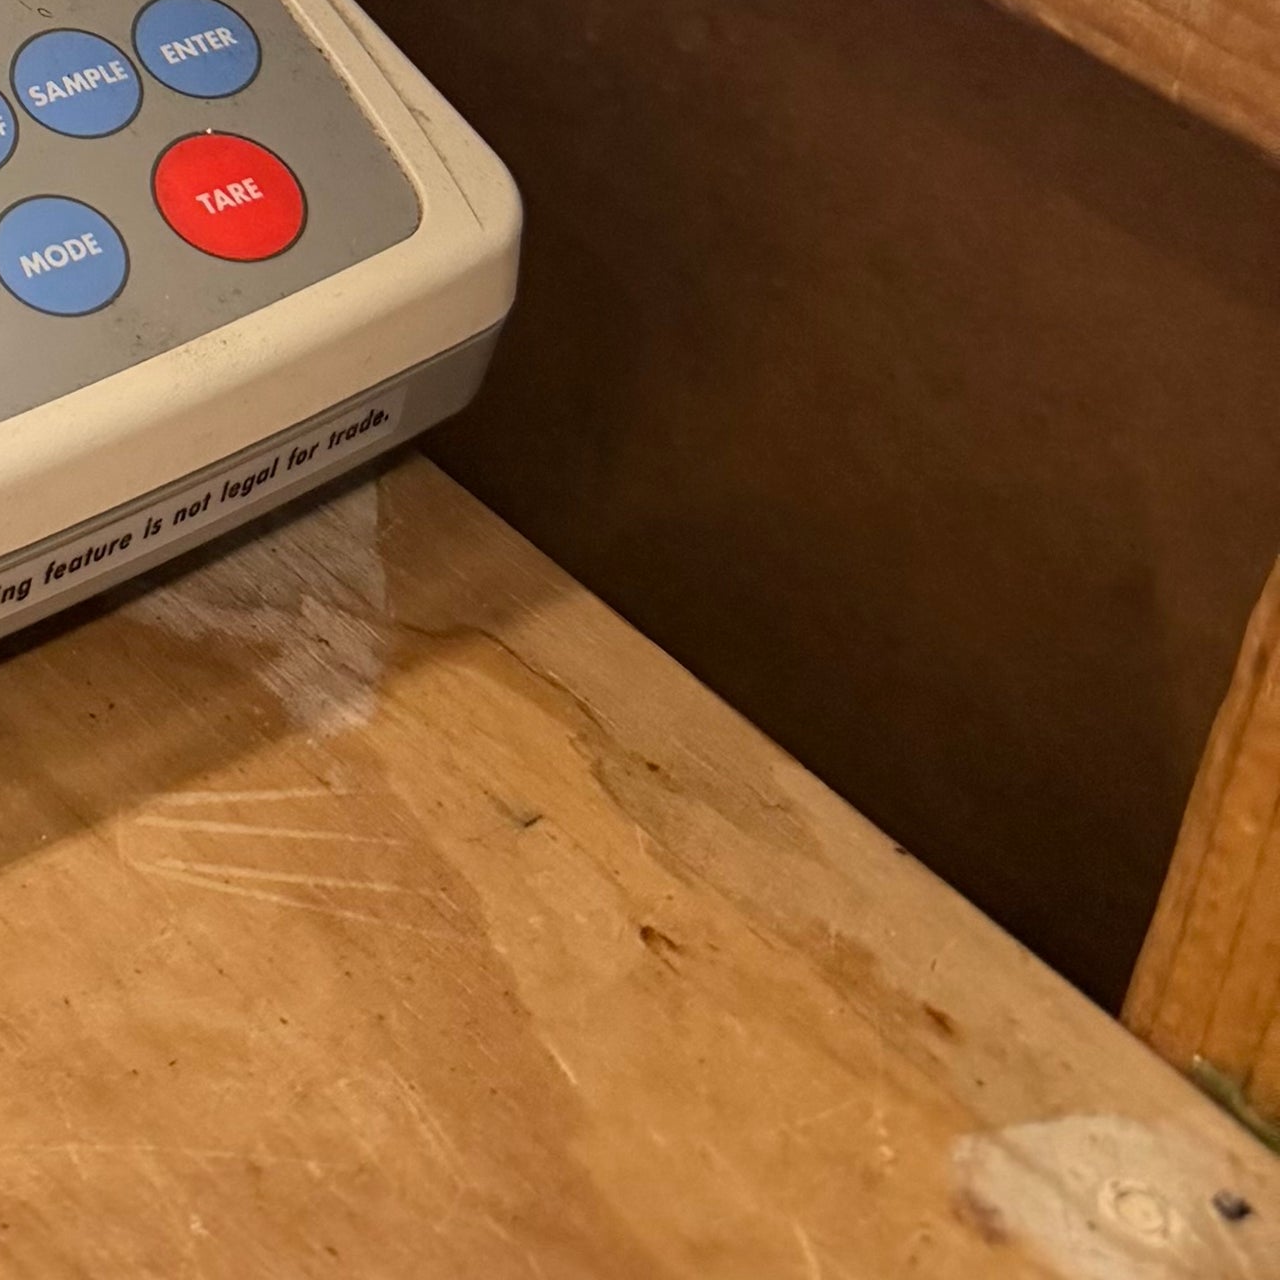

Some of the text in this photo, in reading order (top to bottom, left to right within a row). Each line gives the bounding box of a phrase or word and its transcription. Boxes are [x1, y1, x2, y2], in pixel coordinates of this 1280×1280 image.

[159, 27, 238, 66] ENTER
[28, 60, 129, 108] SAMPLE
[196, 177, 264, 215] TARE
[18, 233, 103, 279] MODE
[42, 530, 133, 585] feature
[141, 516, 162, 539] is
[171, 491, 213, 530] not
[220, 457, 279, 503] legal
[285, 440, 320, 471] for
[327, 406, 390, 450] trade.
